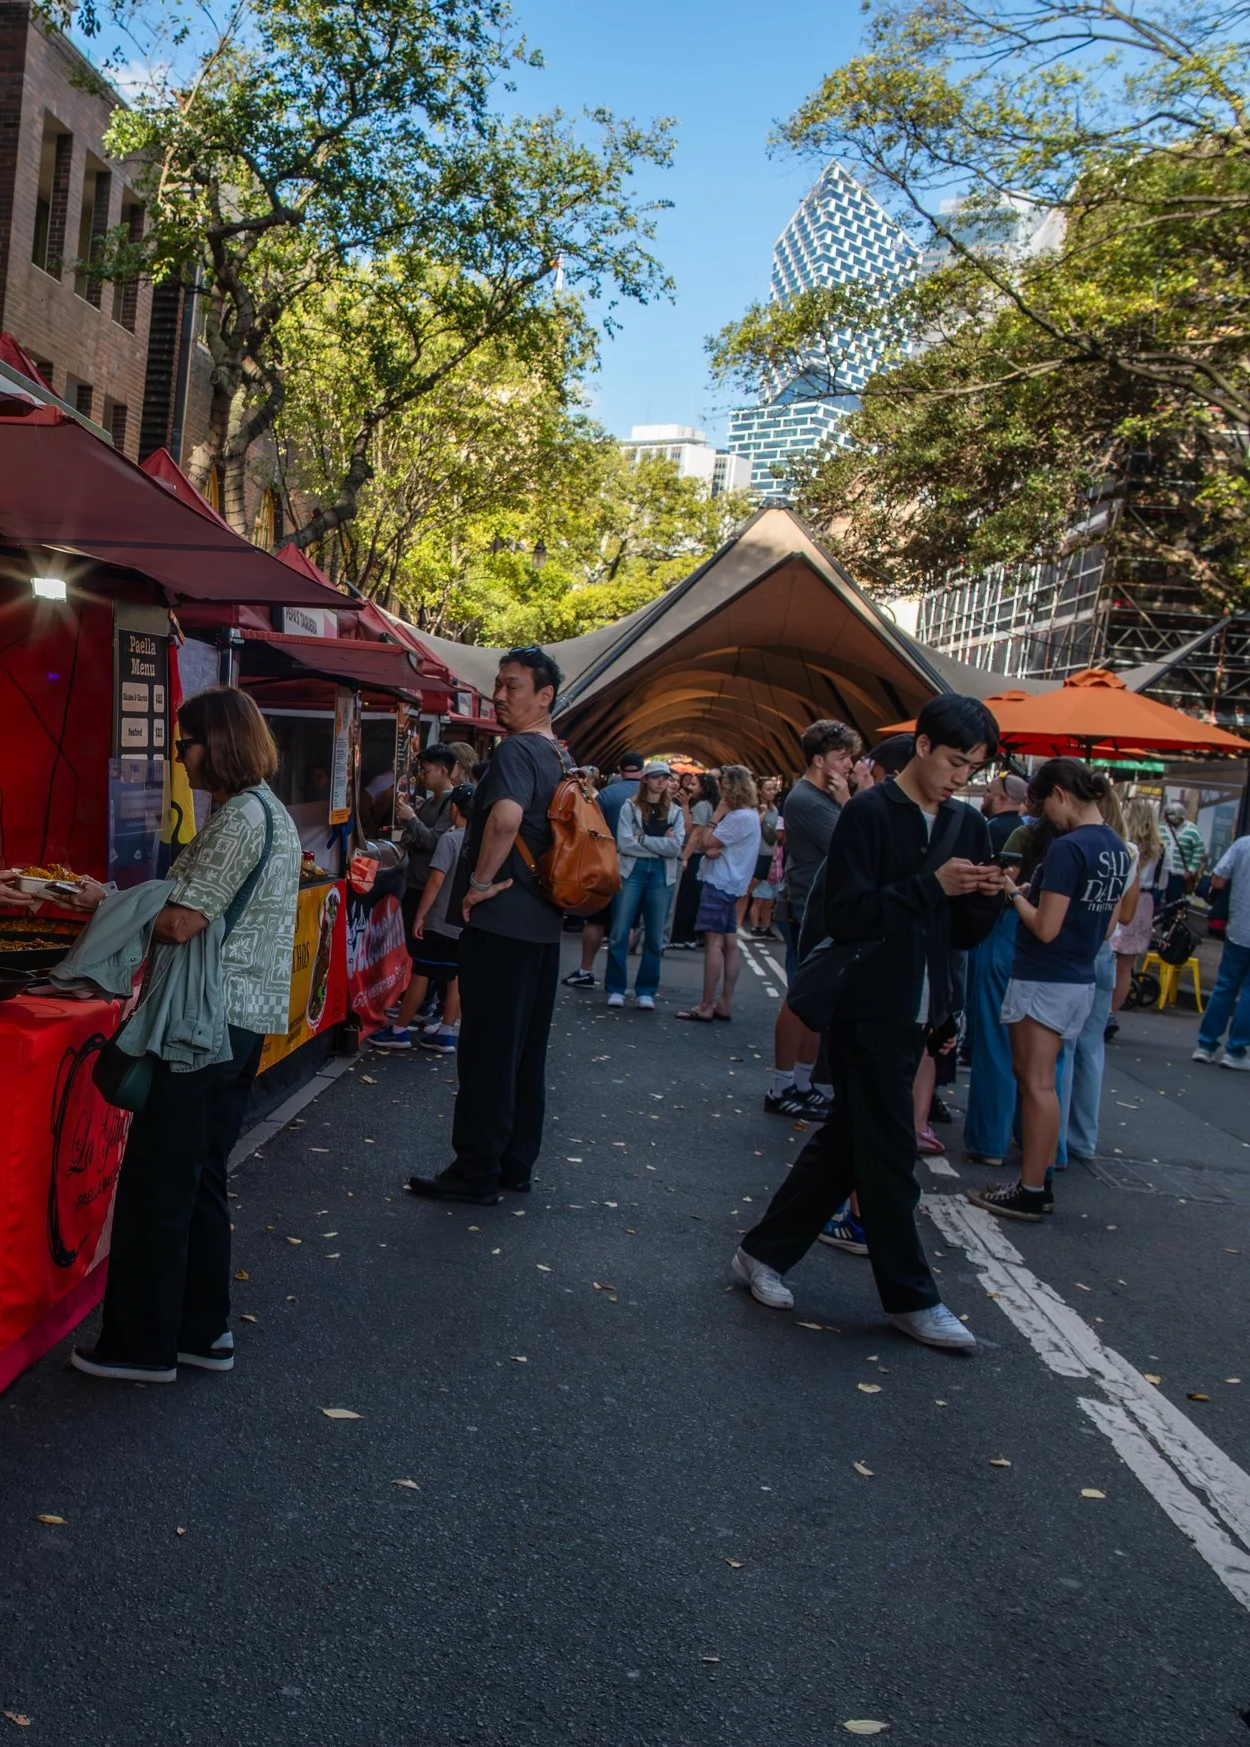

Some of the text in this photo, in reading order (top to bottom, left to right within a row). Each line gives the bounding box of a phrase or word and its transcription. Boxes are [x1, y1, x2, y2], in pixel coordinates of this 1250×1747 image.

[129, 635, 156, 655] Paella
[130, 658, 155, 677] Menu
[1097, 850, 1130, 878] SAD
